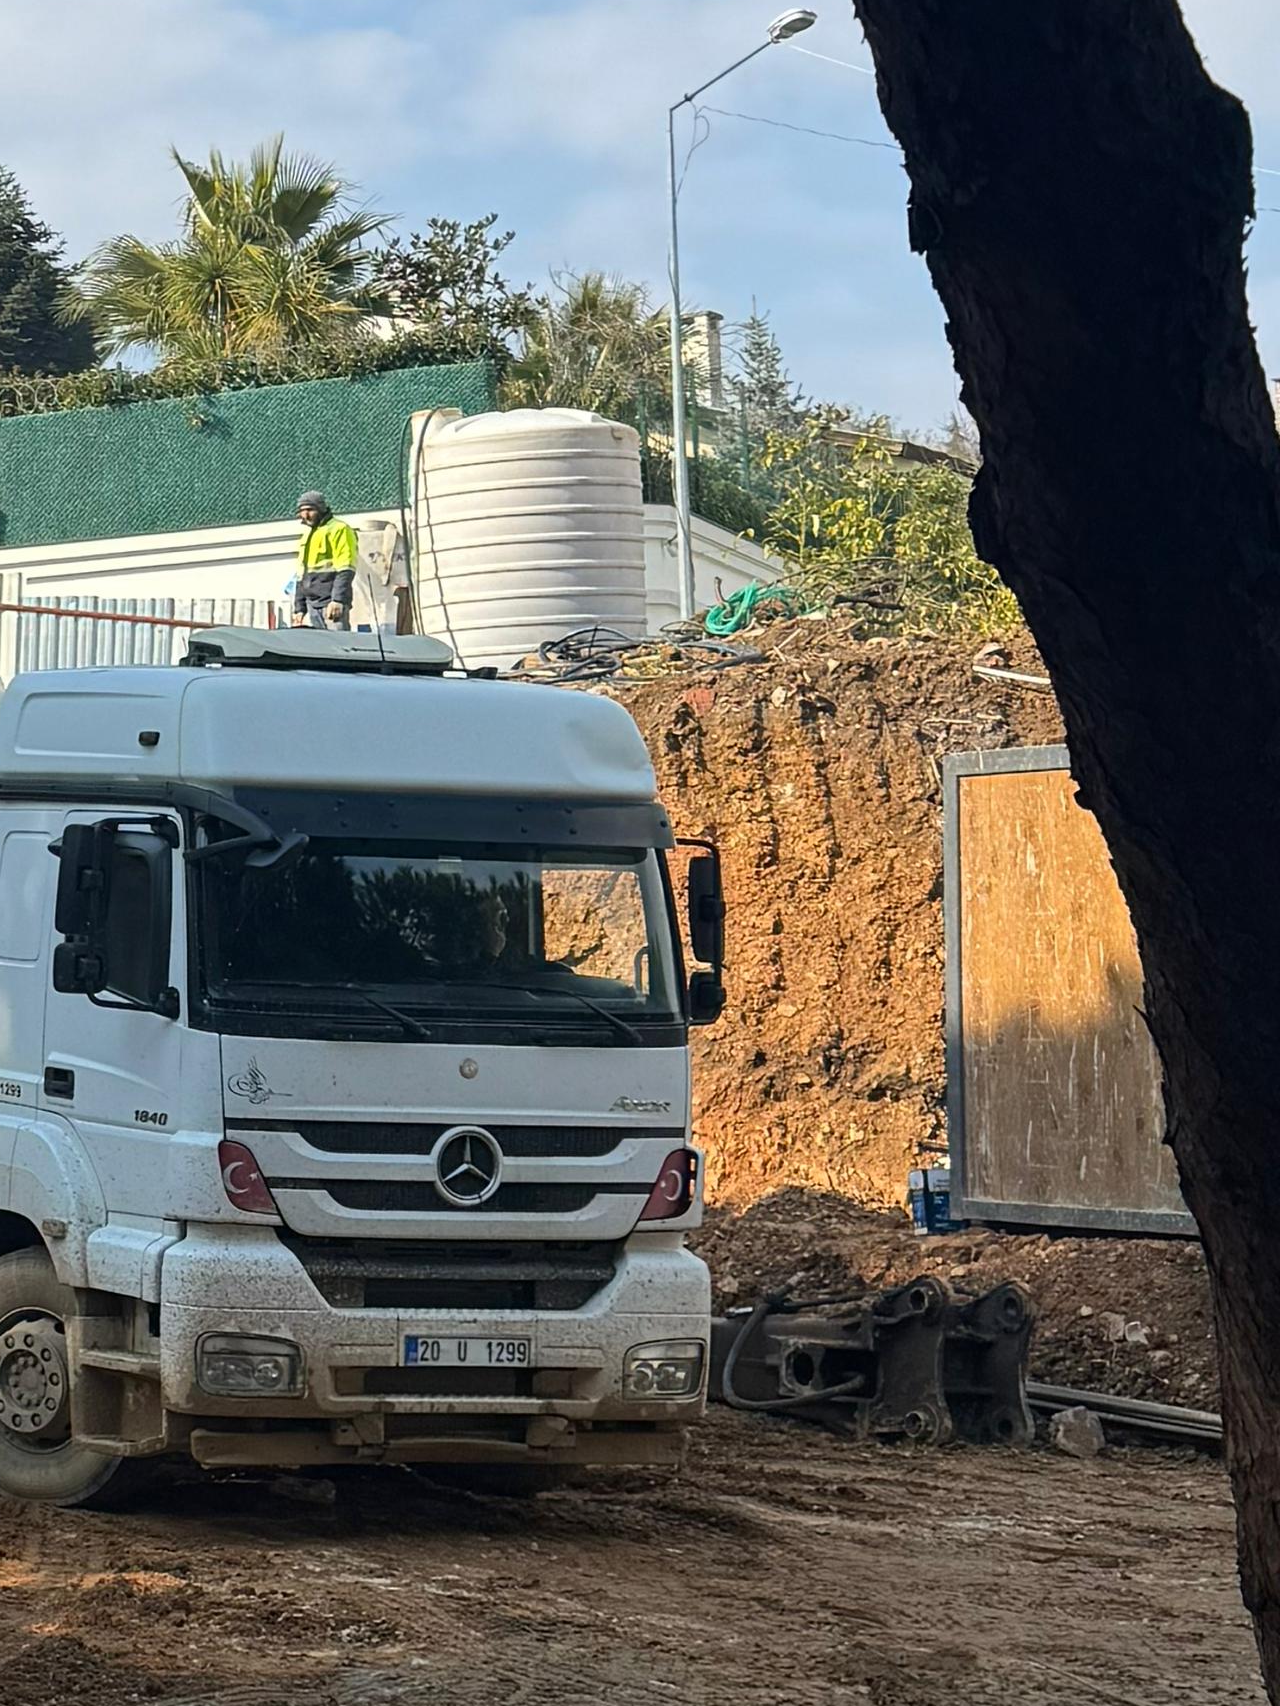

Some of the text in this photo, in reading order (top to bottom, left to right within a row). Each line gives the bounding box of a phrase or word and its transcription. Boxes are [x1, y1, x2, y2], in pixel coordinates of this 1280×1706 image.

[134, 1109, 168, 1126] 1840
[419, 1340, 440, 1362] 20
[457, 1340, 468, 1362] U
[487, 1341, 527, 1363] 1299
